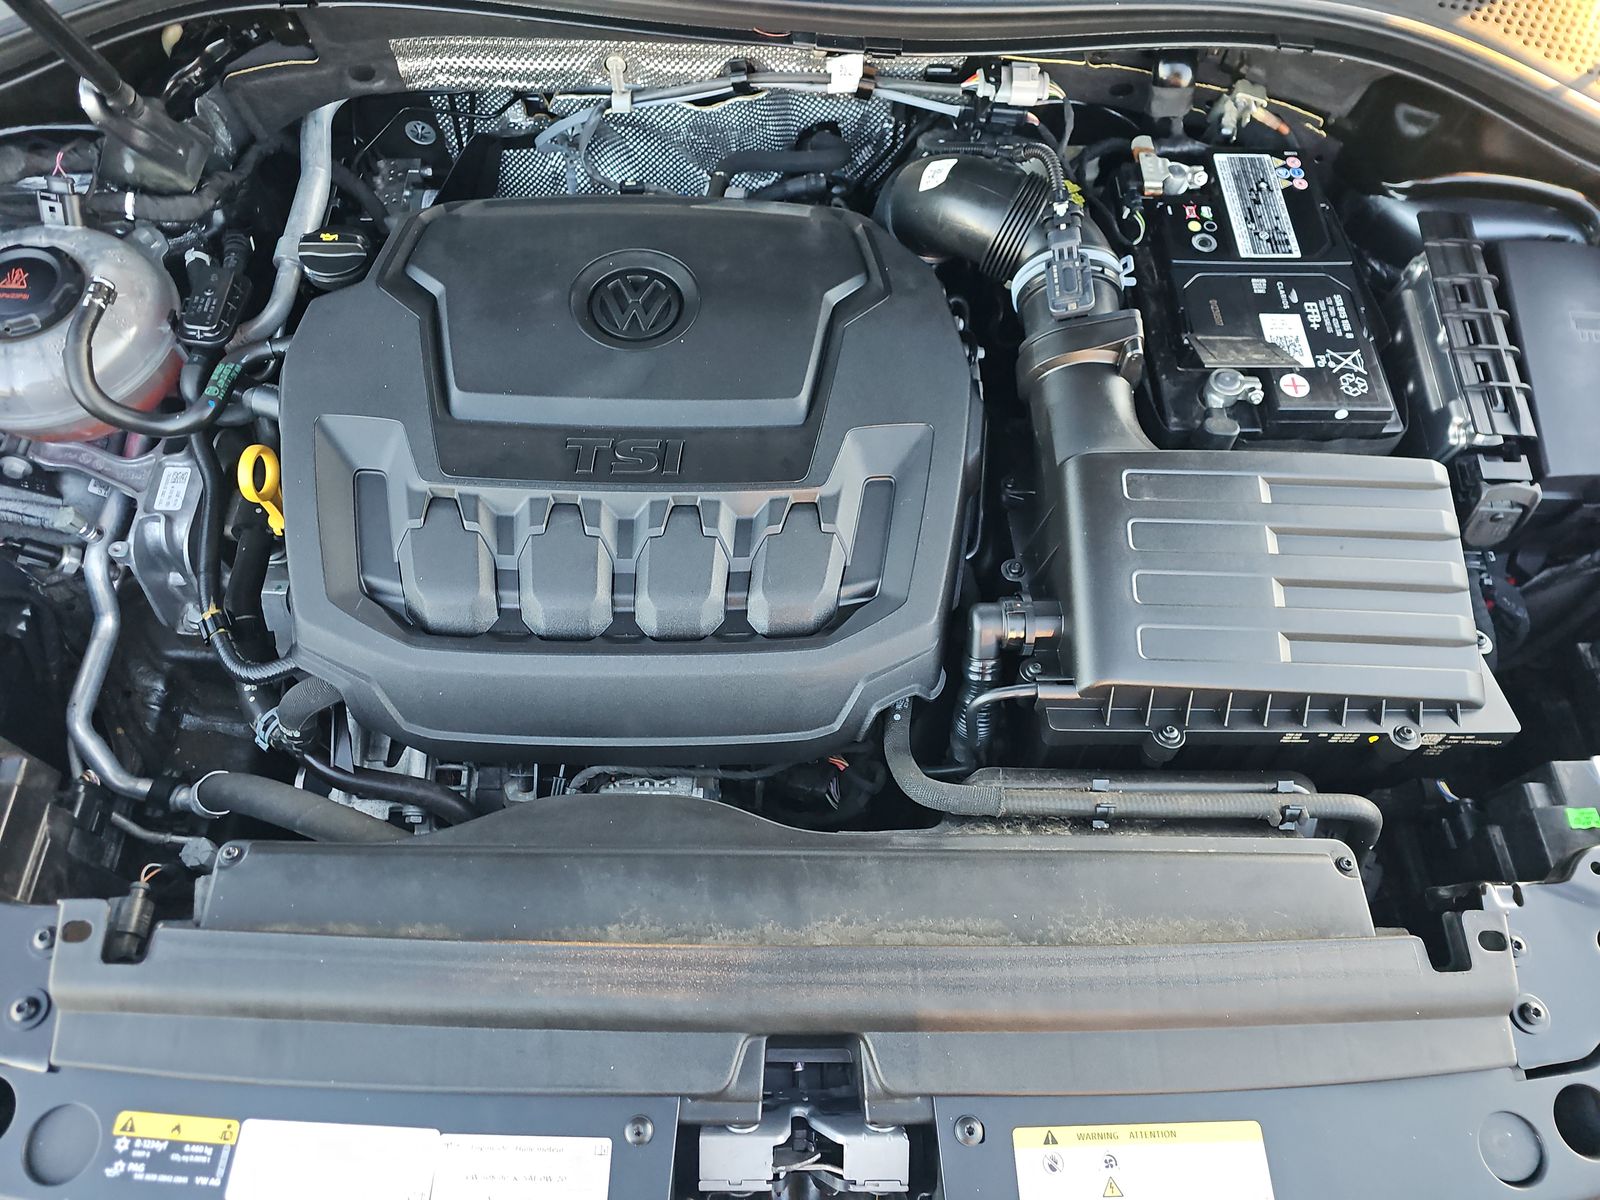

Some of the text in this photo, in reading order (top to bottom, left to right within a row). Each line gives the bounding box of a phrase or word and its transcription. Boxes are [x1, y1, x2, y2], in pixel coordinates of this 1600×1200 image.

[565, 437, 686, 476] TSI
[1076, 1129, 1177, 1142] WARNING ATTENTION
